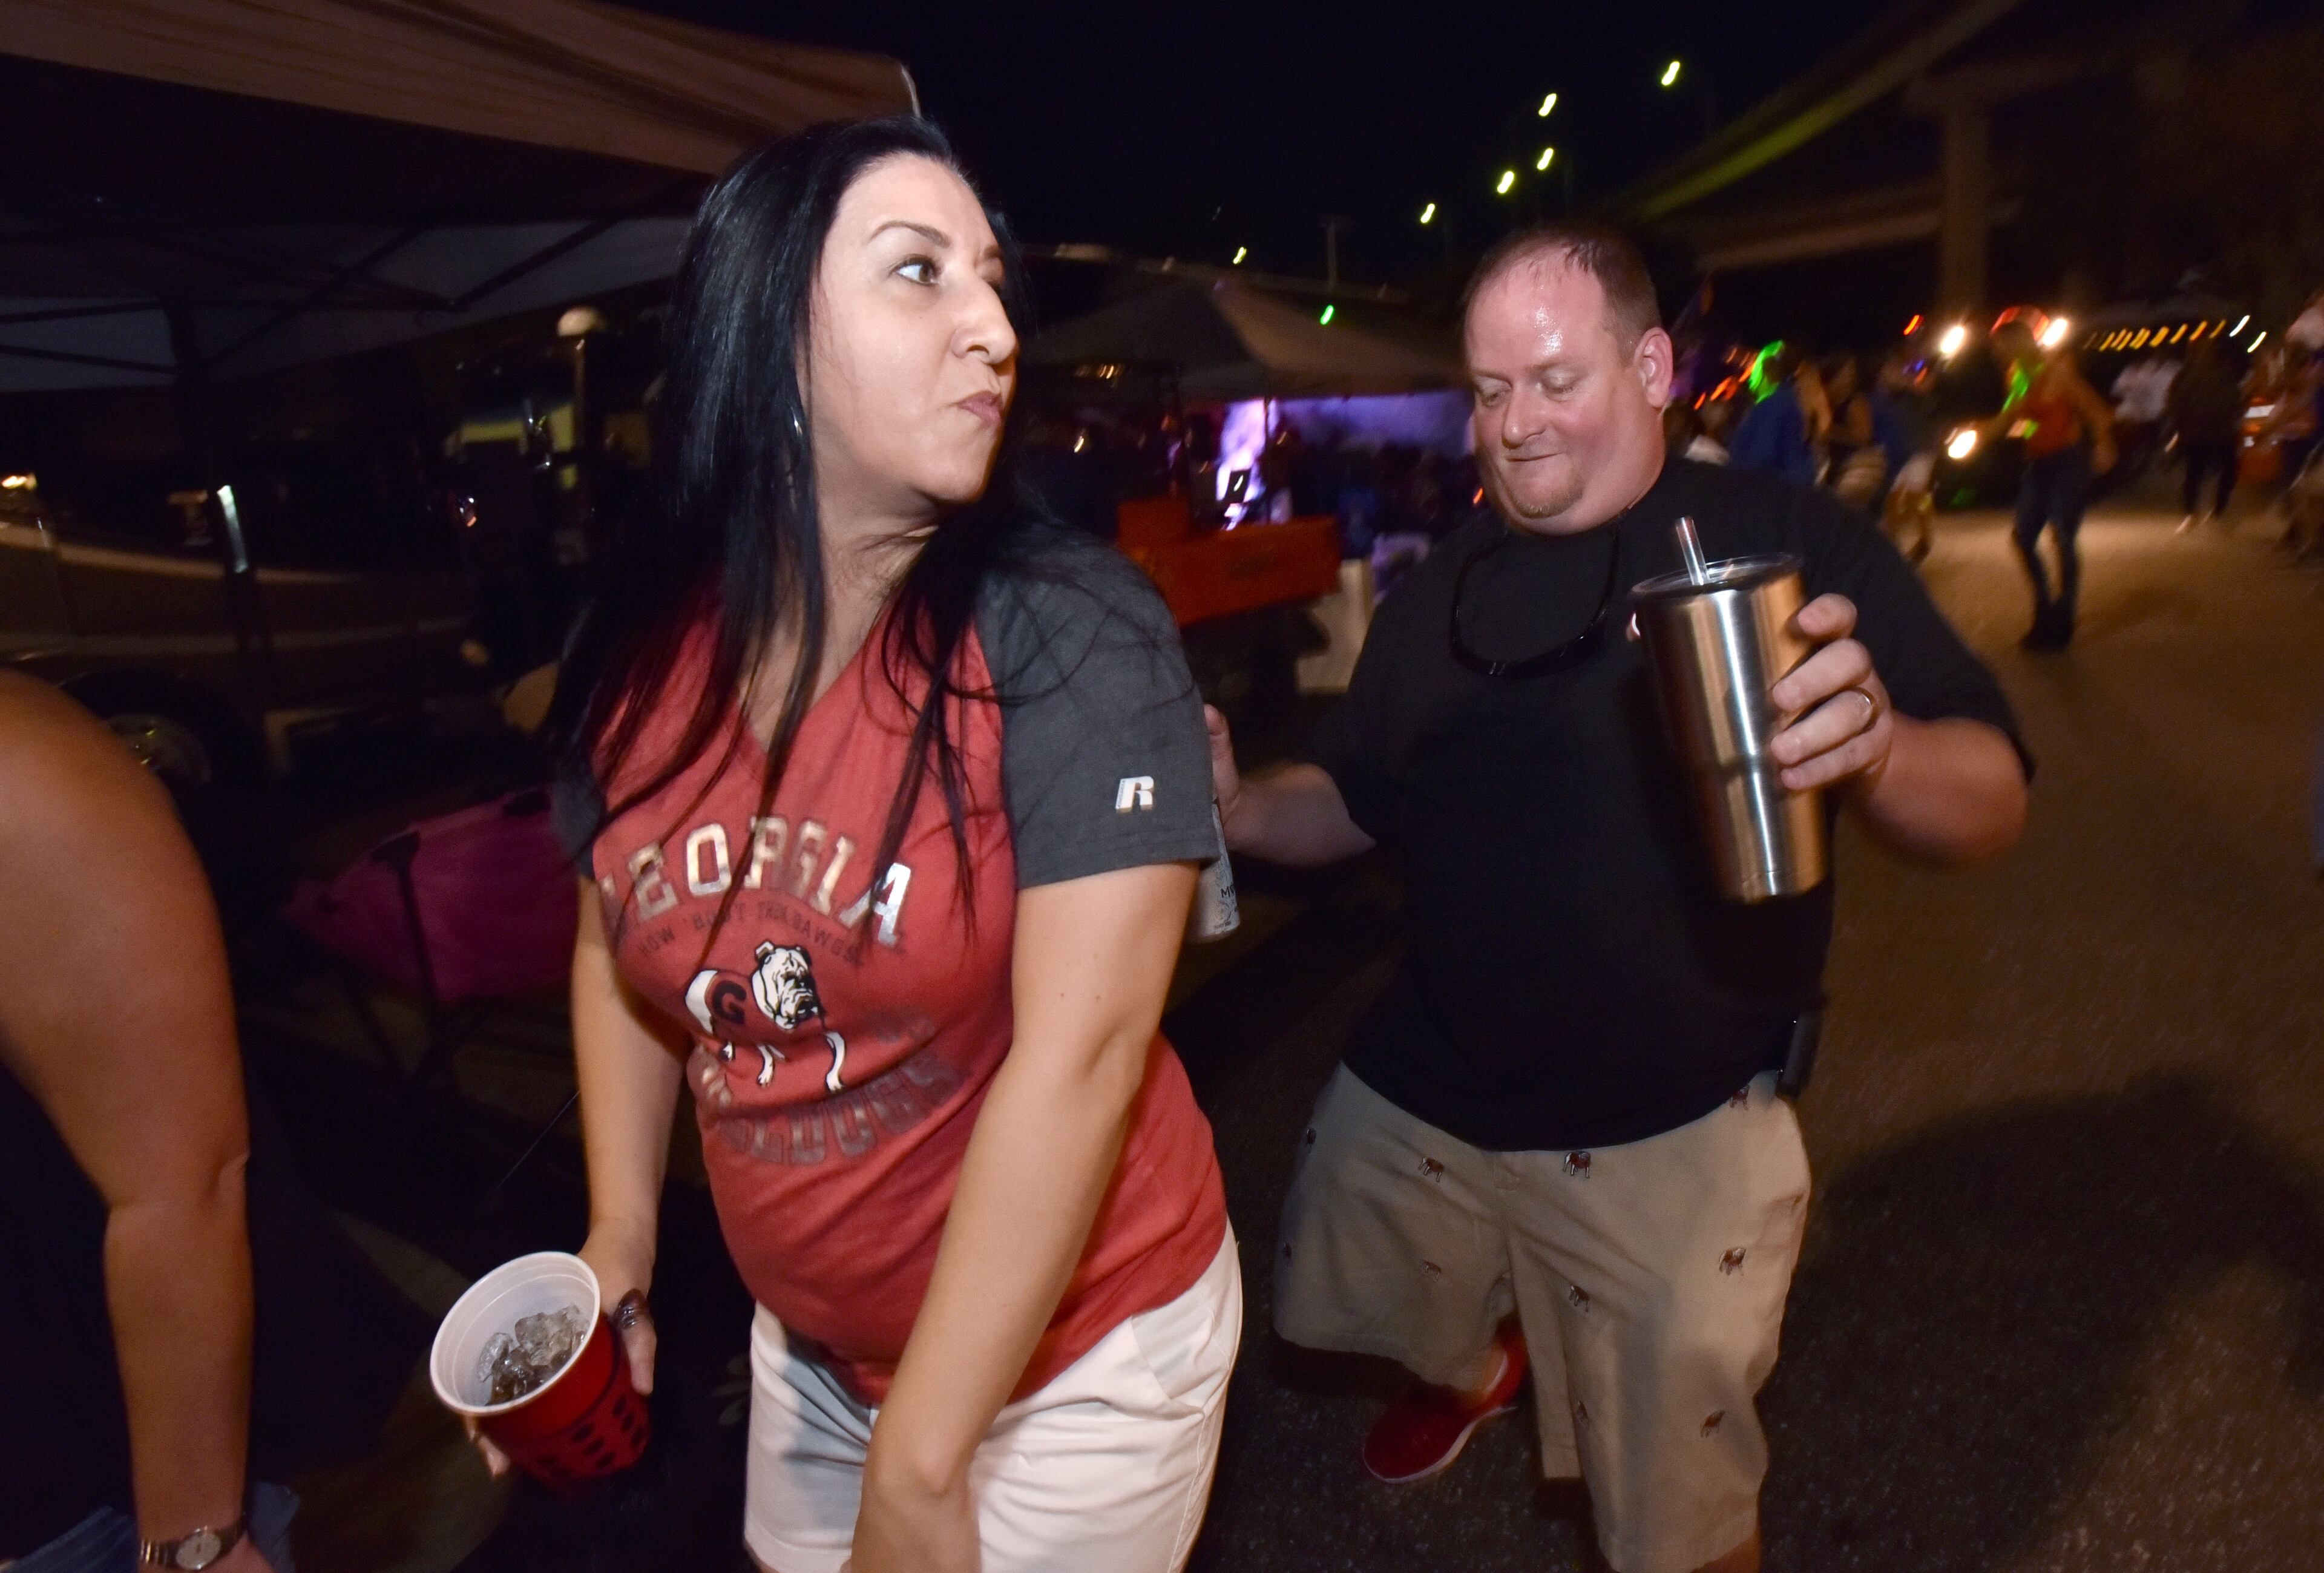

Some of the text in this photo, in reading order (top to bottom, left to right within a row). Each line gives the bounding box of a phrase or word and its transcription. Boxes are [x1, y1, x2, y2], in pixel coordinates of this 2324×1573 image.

[1115, 775, 1154, 812] R
[600, 816, 912, 948] EORGIA
[712, 980, 747, 1025] G
